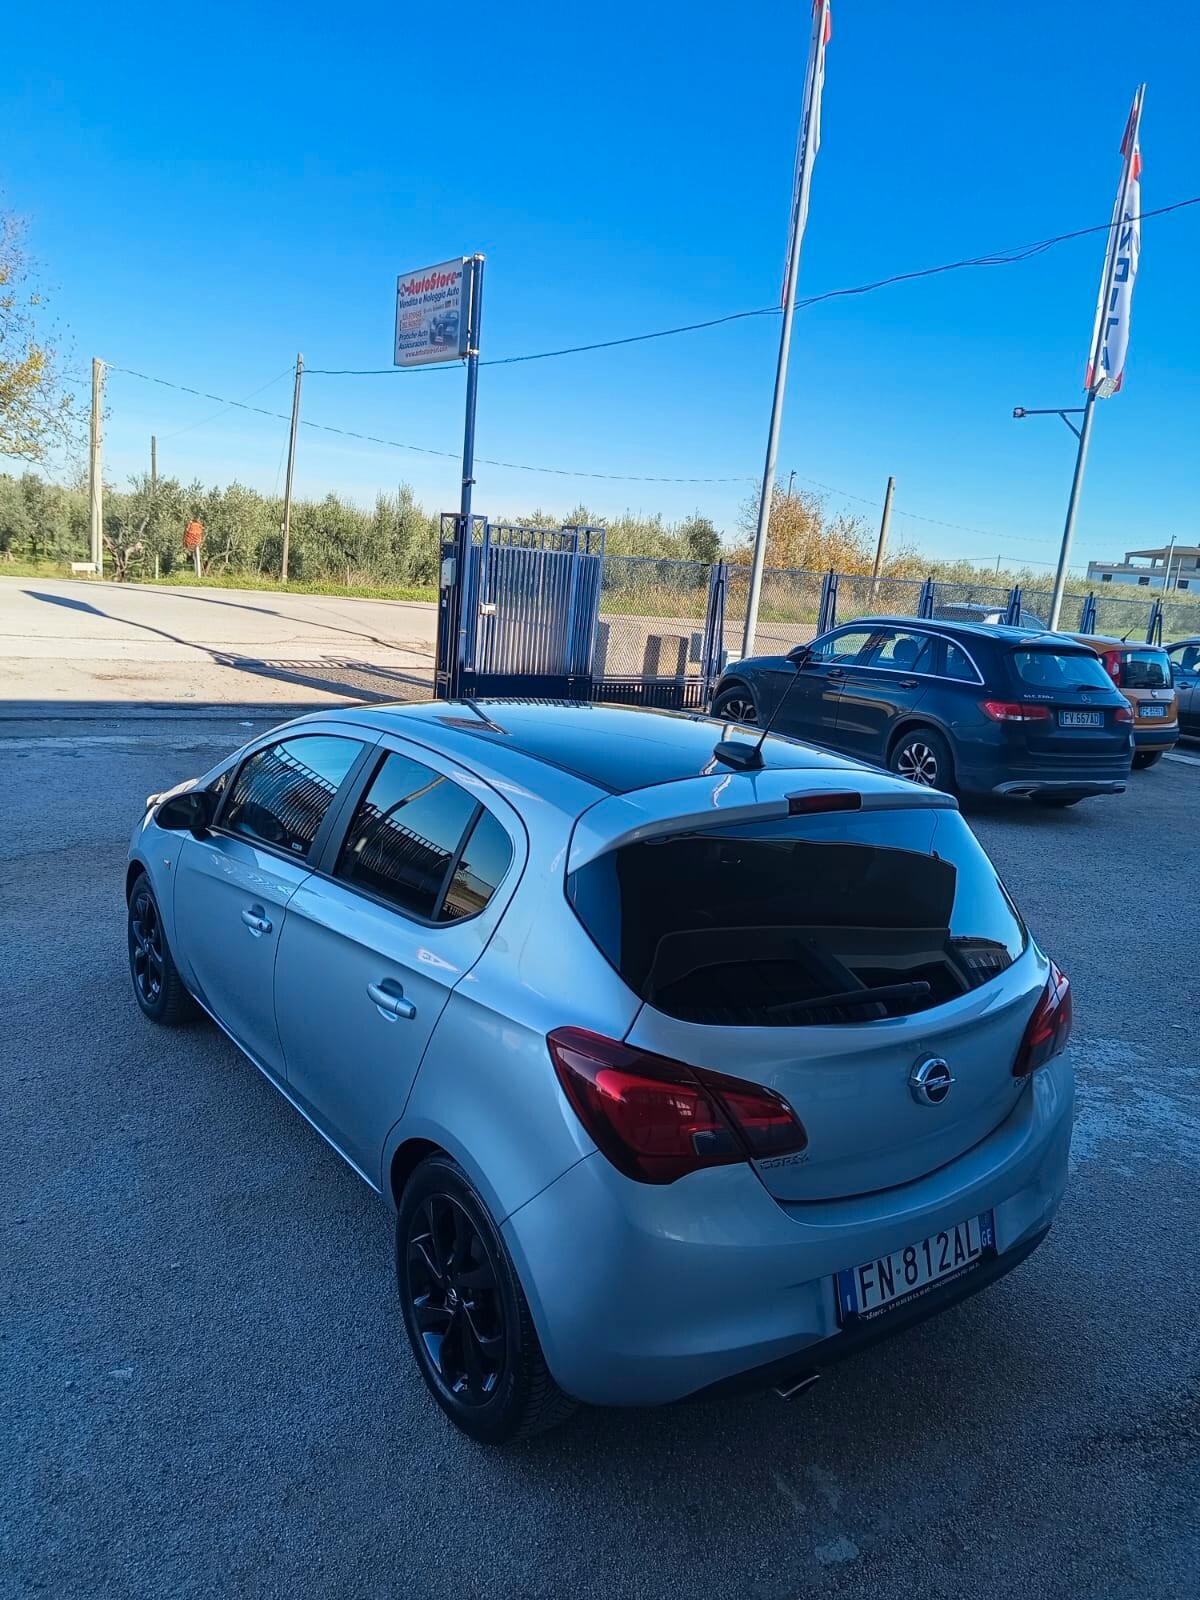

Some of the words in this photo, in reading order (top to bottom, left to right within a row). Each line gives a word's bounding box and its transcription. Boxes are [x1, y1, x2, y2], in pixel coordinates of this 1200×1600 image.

[408, 272, 457, 296] AutoStore
[400, 297, 418, 309] Vendita
[446, 287, 460, 298] Auto
[981, 1228, 992, 1247] GE
[858, 1256, 895, 1309] FN
[902, 1222, 980, 1286] 812AL
